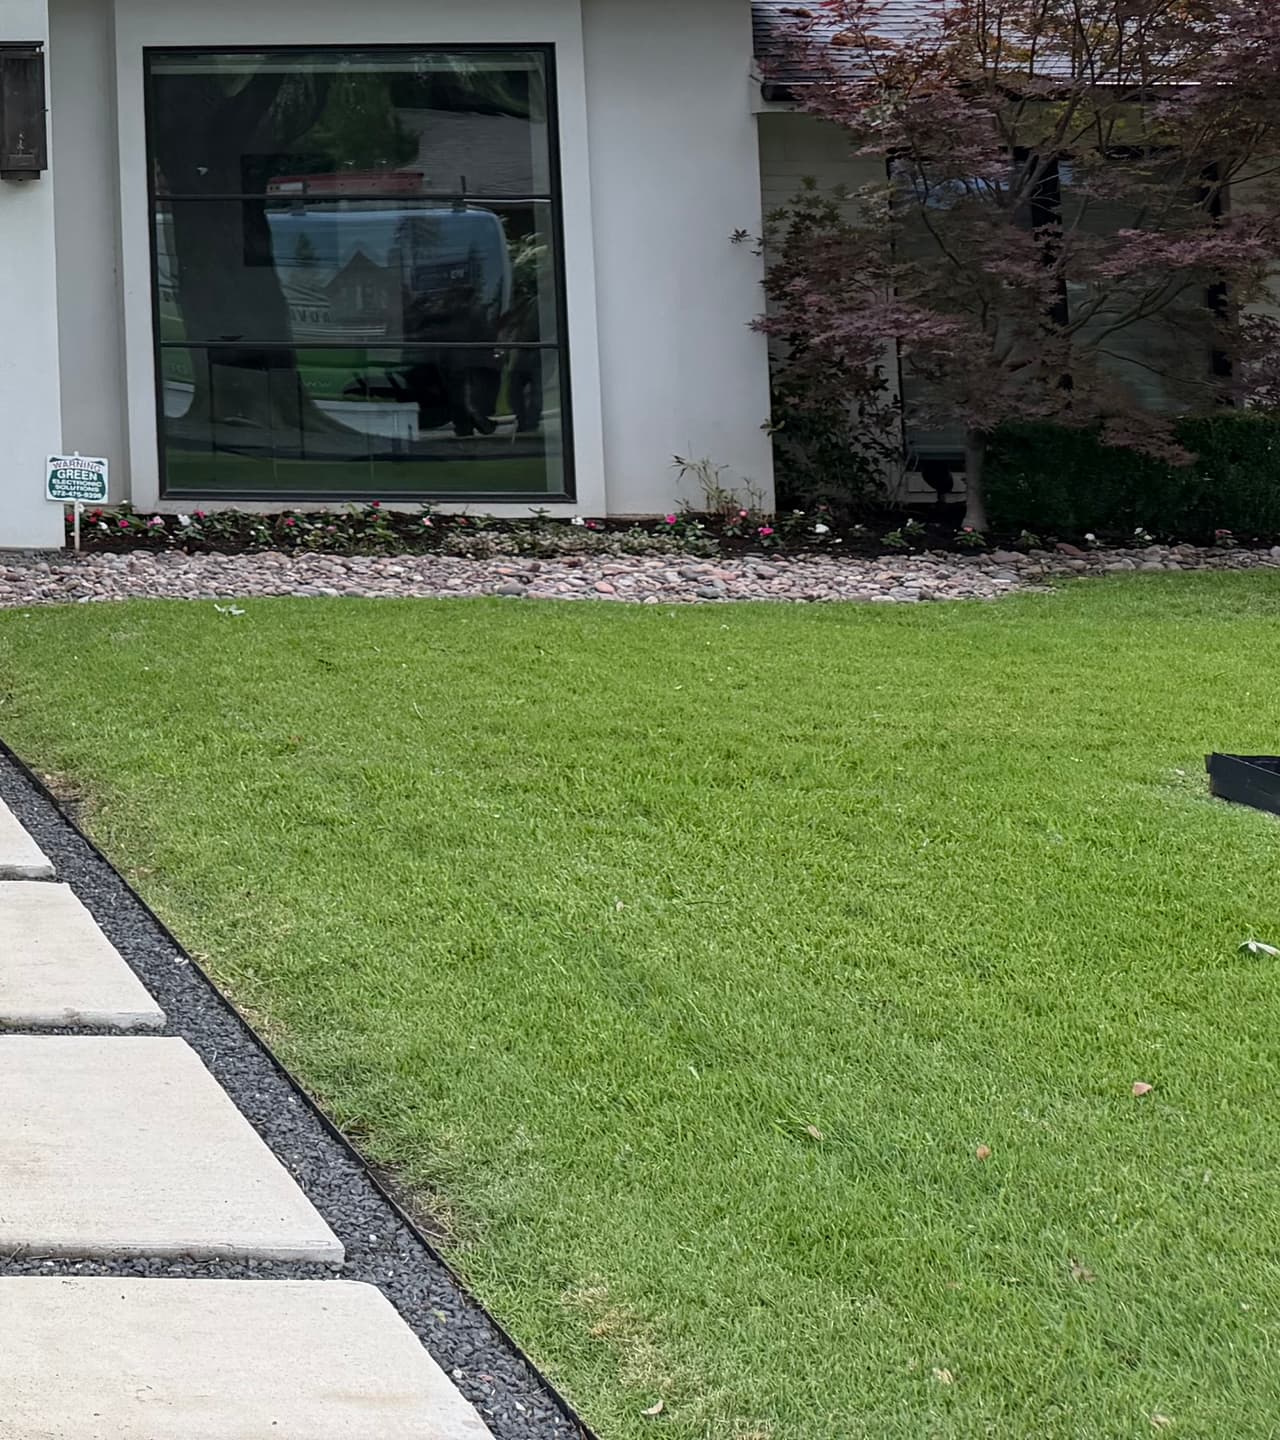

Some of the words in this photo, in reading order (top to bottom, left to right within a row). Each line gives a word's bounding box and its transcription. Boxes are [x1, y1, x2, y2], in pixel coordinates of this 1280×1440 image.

[53, 460, 101, 473] WARNING
[57, 469, 98, 481] GREEN
[52, 478, 102, 487] ELECTRONIC
[55, 484, 100, 492] SOLUTIONS
